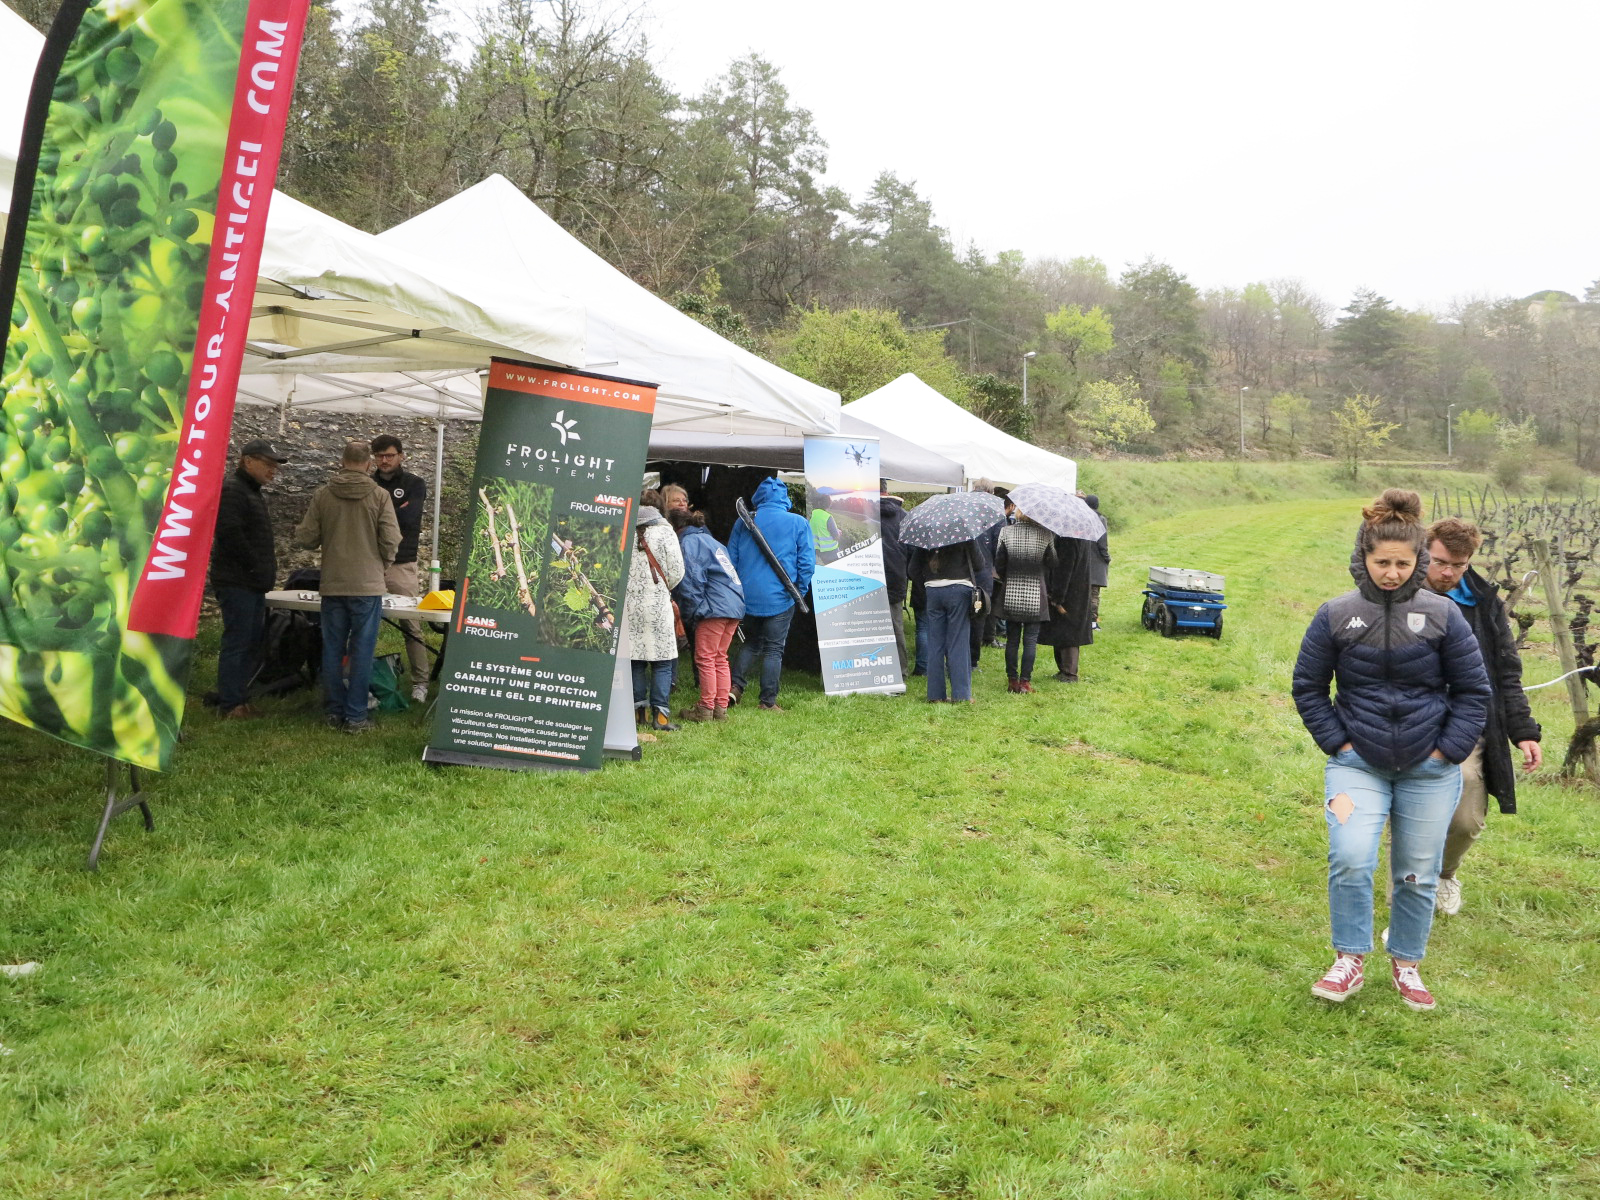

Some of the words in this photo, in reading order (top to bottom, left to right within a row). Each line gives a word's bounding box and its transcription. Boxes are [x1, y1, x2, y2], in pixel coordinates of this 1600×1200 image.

[147, 19, 287, 580] WWW.TOUR-ANTIGECOM
[506, 373, 640, 401] WWW.FROLIGHT.COM
[506, 444, 615, 470] FROLIGHT
[505, 459, 611, 482] SYSTEMS
[596, 494, 624, 505] AVEC
[466, 616, 495, 627] SANS
[470, 661, 482, 669] LE
[486, 663, 532, 676] SYSTÈME
[536, 670, 554, 679] QUI
[558, 673, 585, 683] VOUS
[832, 656, 893, 670] MAXIDRONE
[454, 672, 506, 685] GARANTIT
[509, 679, 530, 688] UNE
[534, 683, 597, 698] PROTECTION
[446, 684, 487, 695] CONTRE
[506, 692, 524, 700] GEL
[545, 697, 602, 711] PRINTEMPS
[452, 718, 485, 727] viticulteurs
[500, 724, 535, 734] dommages
[555, 722, 582, 730] soulager
[493, 743, 535, 752] entièrement
[510, 735, 546, 745] installations
[547, 740, 586, 750] garantissent
